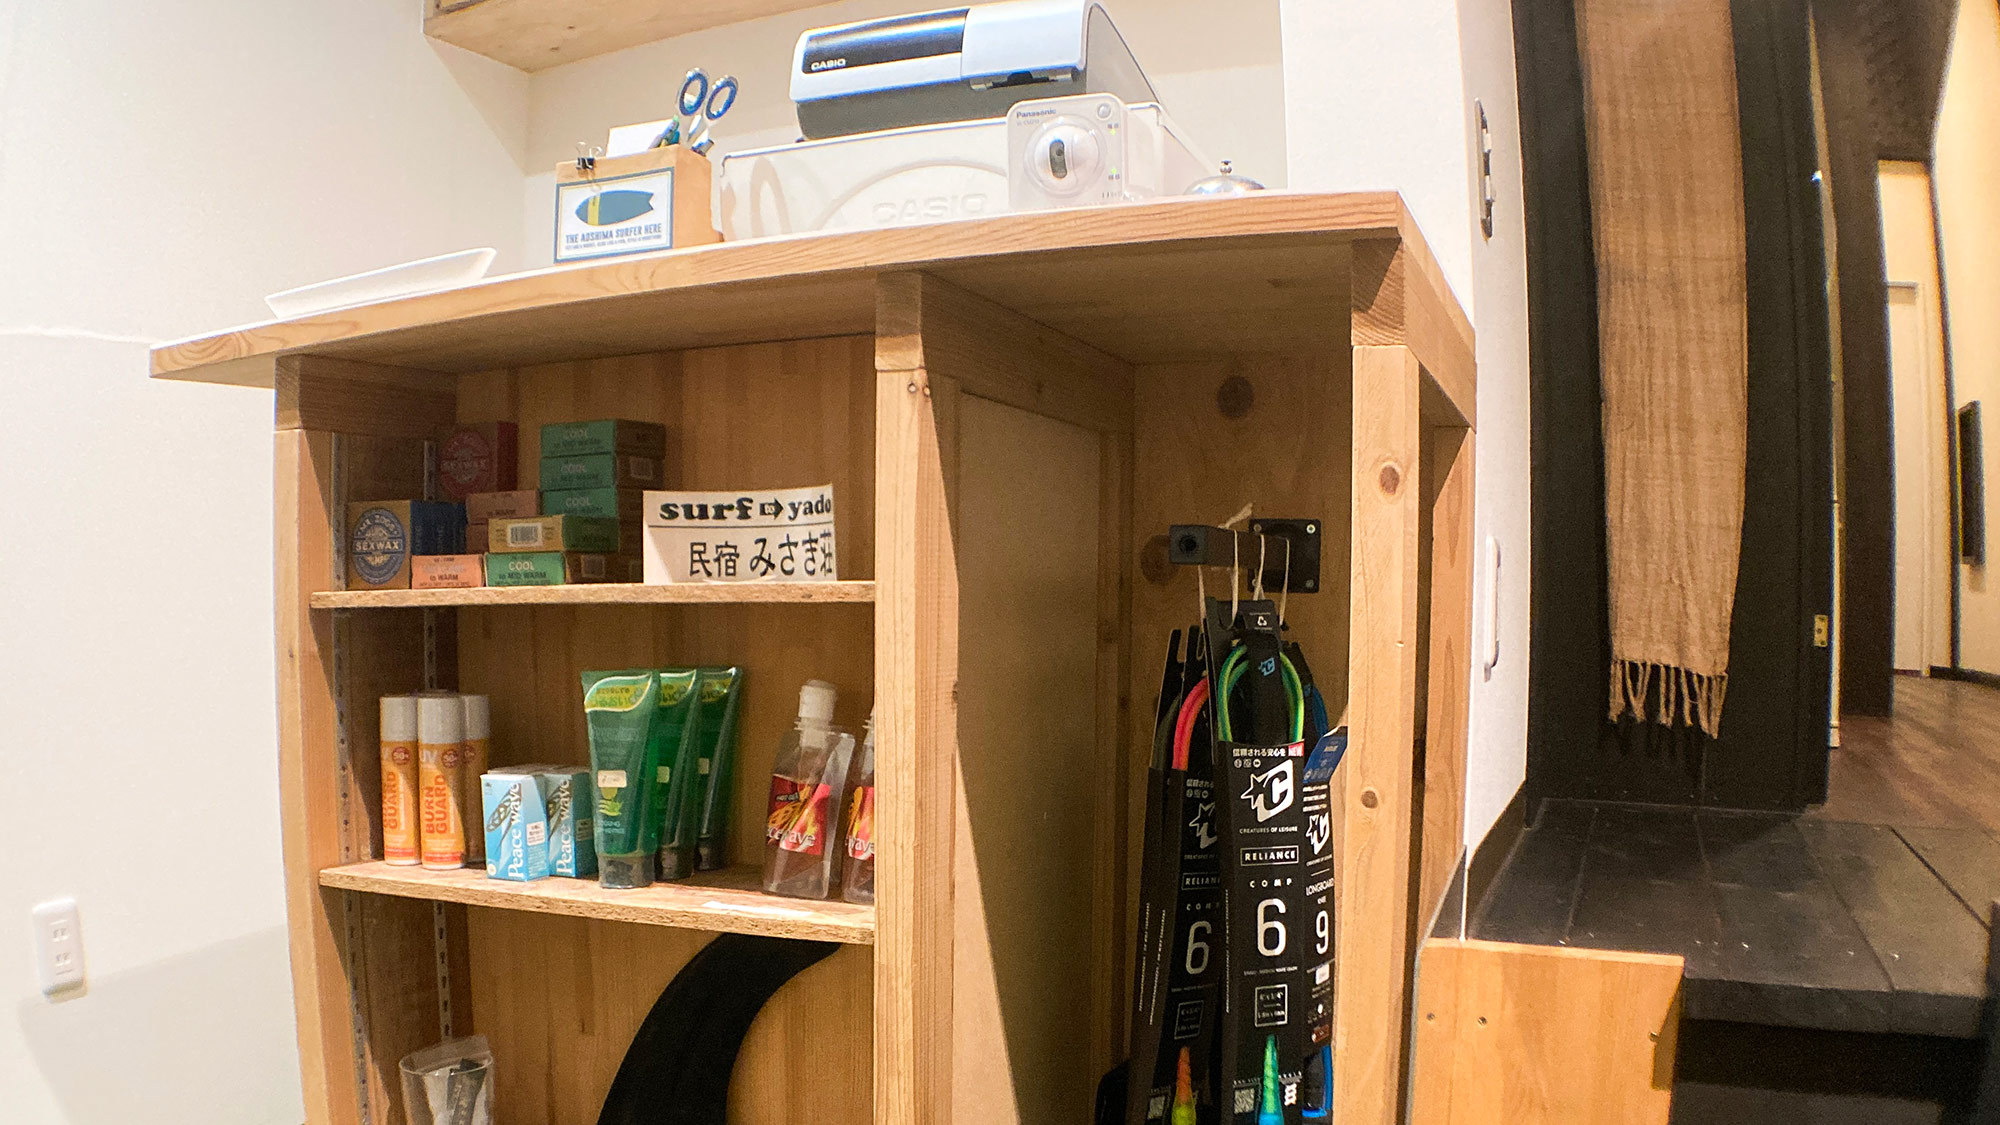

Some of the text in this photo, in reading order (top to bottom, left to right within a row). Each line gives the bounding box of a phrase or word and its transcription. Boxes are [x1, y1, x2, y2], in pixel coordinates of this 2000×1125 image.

[811, 58, 846, 71] CASIO
[1016, 107, 1057, 118] Panasonic
[872, 193, 987, 223] CASIO
[566, 234, 579, 244] THE
[581, 230, 614, 242] AOSHIMA
[616, 226, 642, 238] SURFER
[644, 223, 662, 234] HERE
[660, 497, 753, 520] surf
[788, 494, 832, 521] yado
[356, 541, 399, 552] SEXWAX
[690, 529, 832, 577] 民宿 みさき荘
[509, 561, 535, 571] COOL
[424, 786, 435, 834] BURN
[435, 774, 448, 835] GUARD
[507, 783, 525, 879] Peace wave
[556, 779, 573, 874] Peace wave
[1244, 850, 1296, 862] RELIANCE
[1249, 877, 1292, 888] COMP
[1256, 898, 1286, 957] 6
[1315, 910, 1329, 955] 9
[1185, 920, 1212, 975] 6
